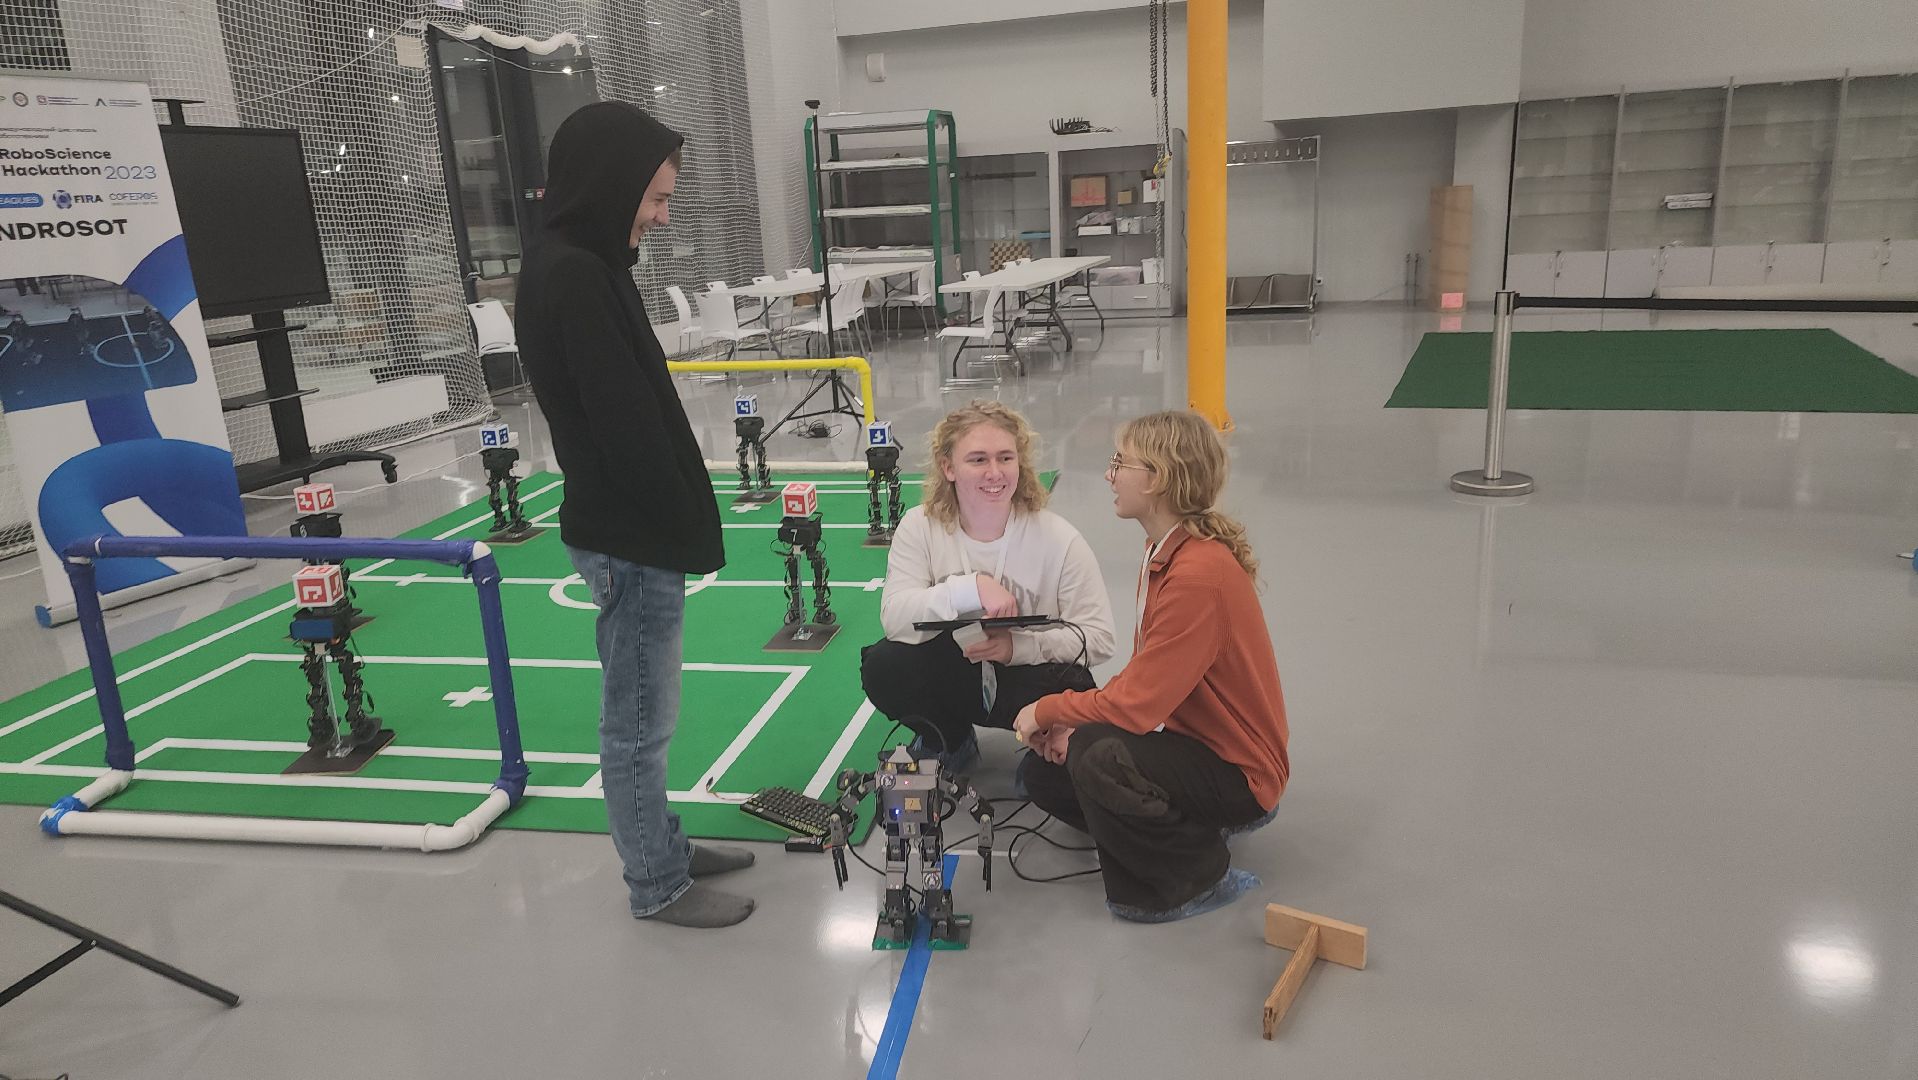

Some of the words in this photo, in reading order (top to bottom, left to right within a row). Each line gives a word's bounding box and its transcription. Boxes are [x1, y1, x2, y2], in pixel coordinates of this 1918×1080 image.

[0, 148, 112, 160] RoboScience
[1, 164, 102, 177] Hackathon
[104, 165, 157, 180] 2023
[73, 194, 104, 204] FIRA
[0, 218, 128, 242] NDROSOT
[790, 528, 798, 542] 7
